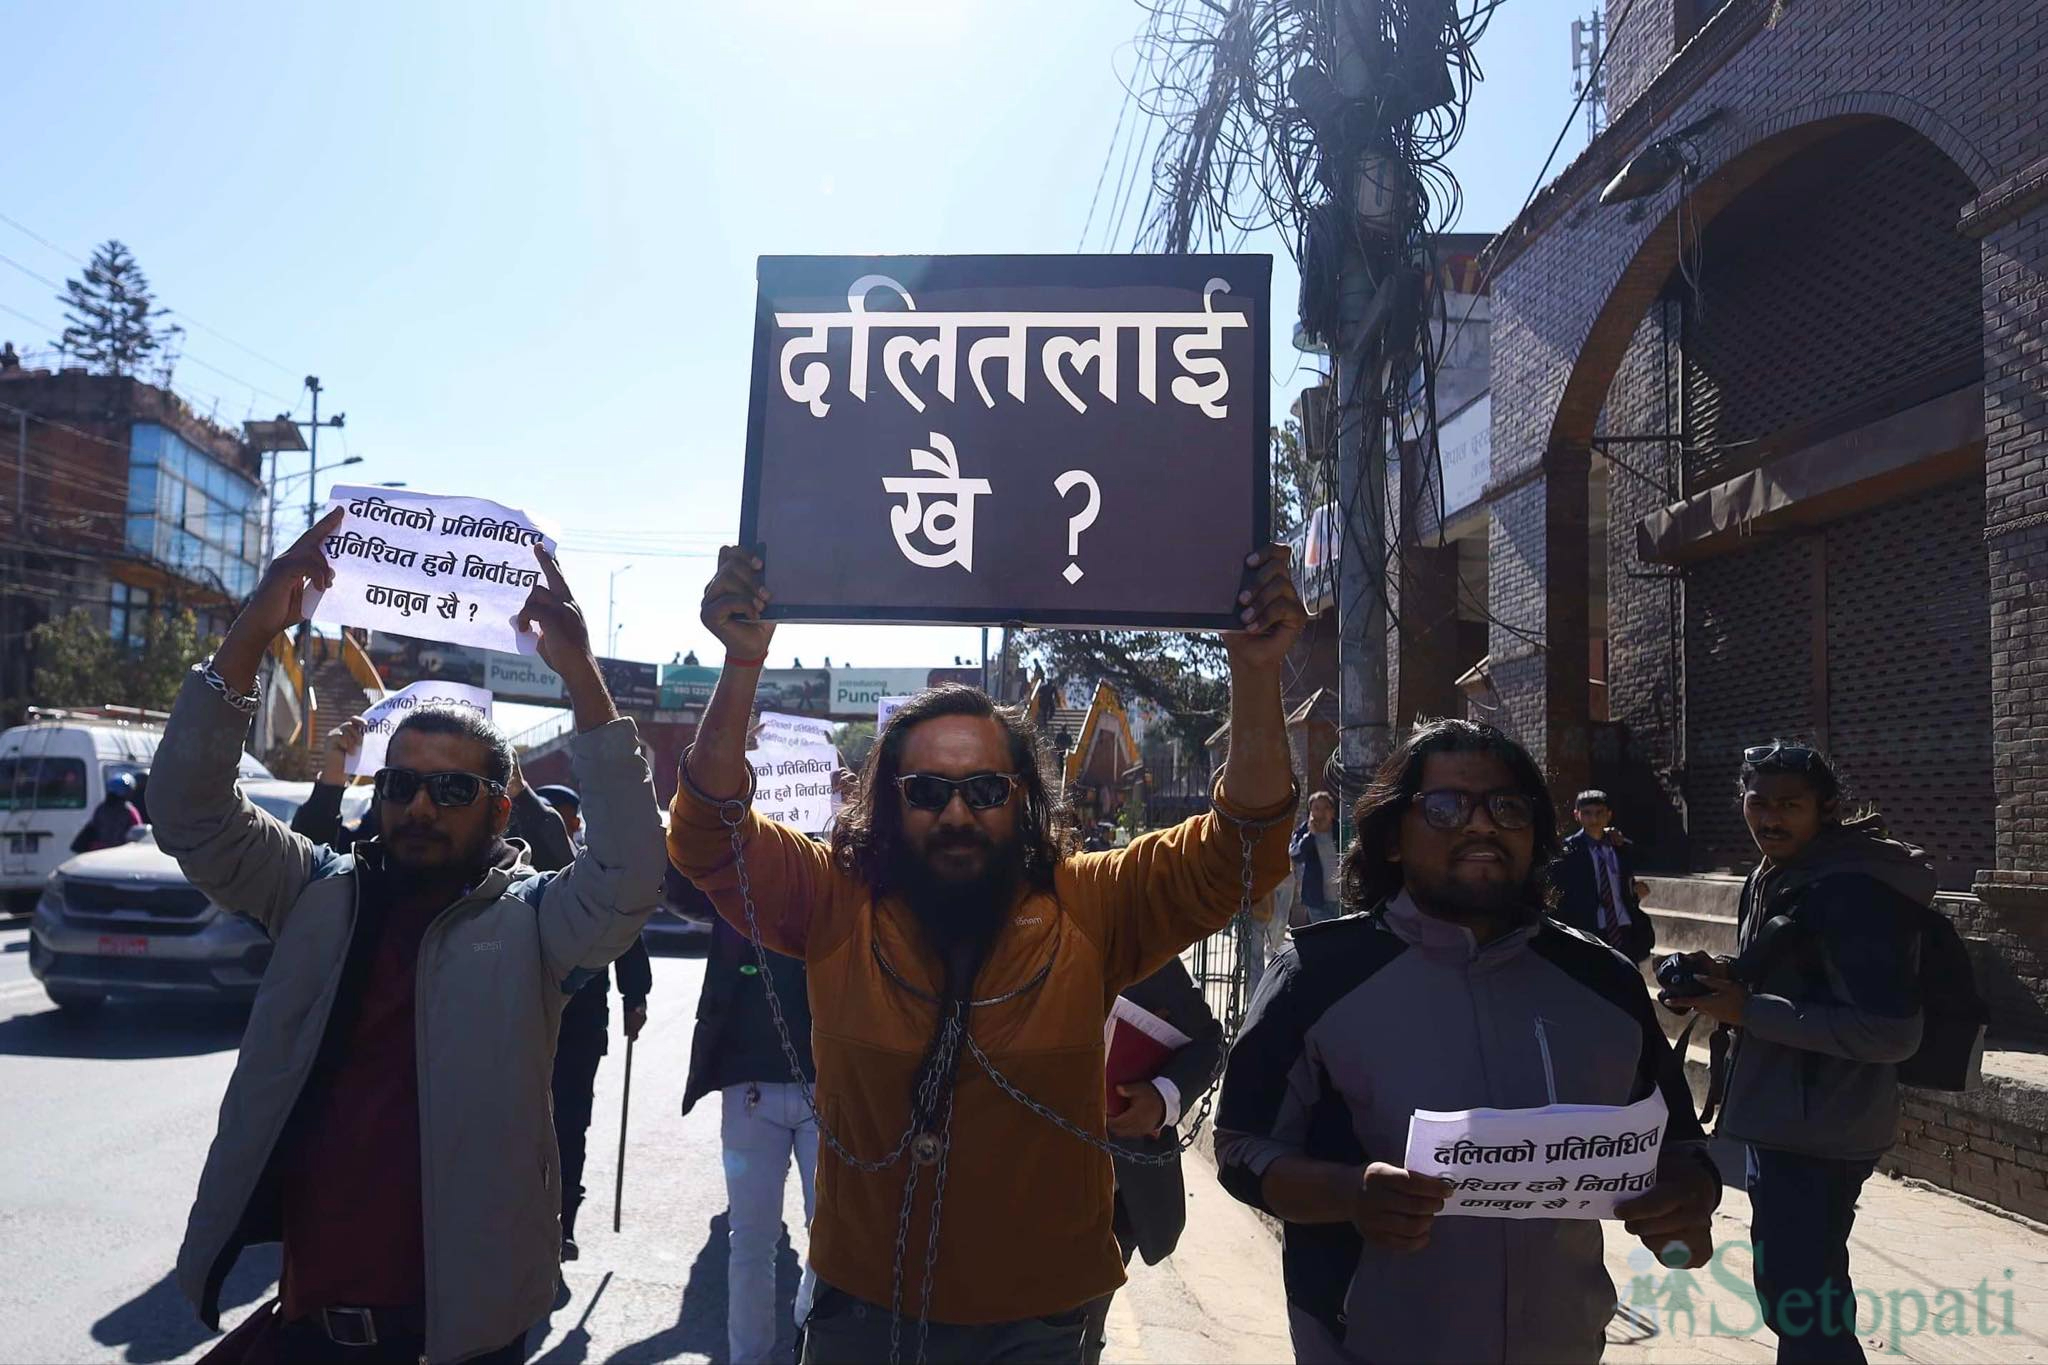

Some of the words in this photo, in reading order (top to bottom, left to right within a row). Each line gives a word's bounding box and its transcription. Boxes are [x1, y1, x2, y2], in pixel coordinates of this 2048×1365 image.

[774, 274, 1249, 419] दलितलाई
[348, 496, 437, 532] दलितको
[882, 431, 993, 573] खै
[1053, 469, 1101, 586] ?
[324, 531, 419, 568] सुनिश्चित
[421, 551, 459, 578] हुने
[461, 554, 541, 588] निर्वाचन
[365, 584, 431, 617] कानुन
[436, 591, 460, 620] खै
[469, 602, 479, 623] ?
[489, 664, 557, 686] Punch.ev
[776, 758, 832, 778] प्रतिनिधित्व
[774, 784, 792, 803] हुने
[788, 806, 800, 821] खै
[804, 809, 810, 821] ?
[1433, 1138, 1538, 1166] दलितको
[1544, 1125, 1660, 1165] प्रतिनिधित्व
[1525, 1175, 1569, 1194] हुने
[1459, 1199, 1538, 1212] कानुन
[1541, 1196, 1569, 1210] खै
[1578, 1199, 1591, 1210] ?
